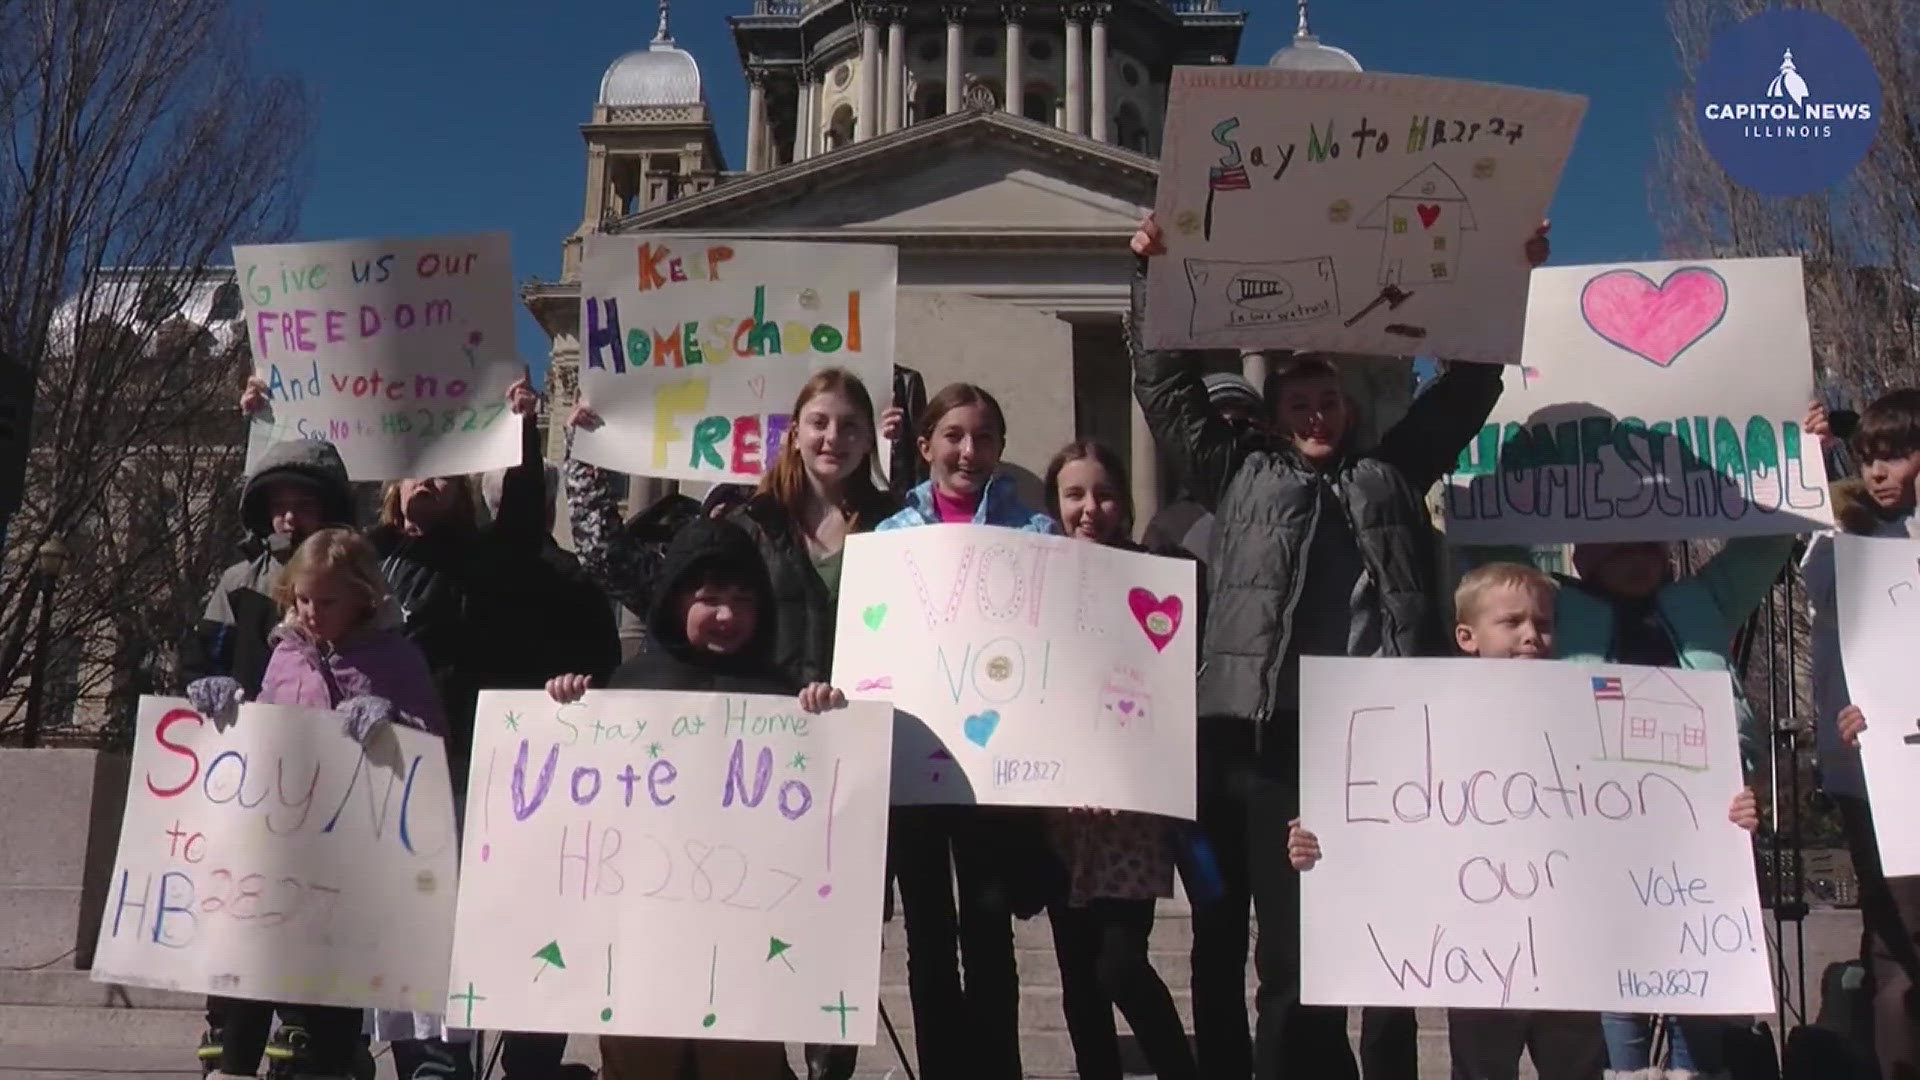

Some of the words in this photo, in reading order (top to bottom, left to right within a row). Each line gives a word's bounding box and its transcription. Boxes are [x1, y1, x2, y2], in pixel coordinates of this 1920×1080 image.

[1211, 117, 1294, 180] Say
[1307, 119, 1340, 163] No
[1351, 117, 1390, 159] to
[246, 263, 329, 306] Give
[351, 254, 395, 283] us
[268, 360, 321, 400] And
[331, 369, 405, 401] vote
[1449, 415, 1824, 521] HOMESCHOOL
[557, 702, 647, 746] Stay
[723, 698, 811, 737] Home
[147, 709, 321, 834] Say
[511, 739, 678, 821] Vote
[722, 739, 812, 820] No
[1345, 704, 1699, 830] Education
[1628, 861, 1715, 907] Vote
[1367, 916, 1540, 1007] Way!
[1679, 906, 1757, 955] NO!
